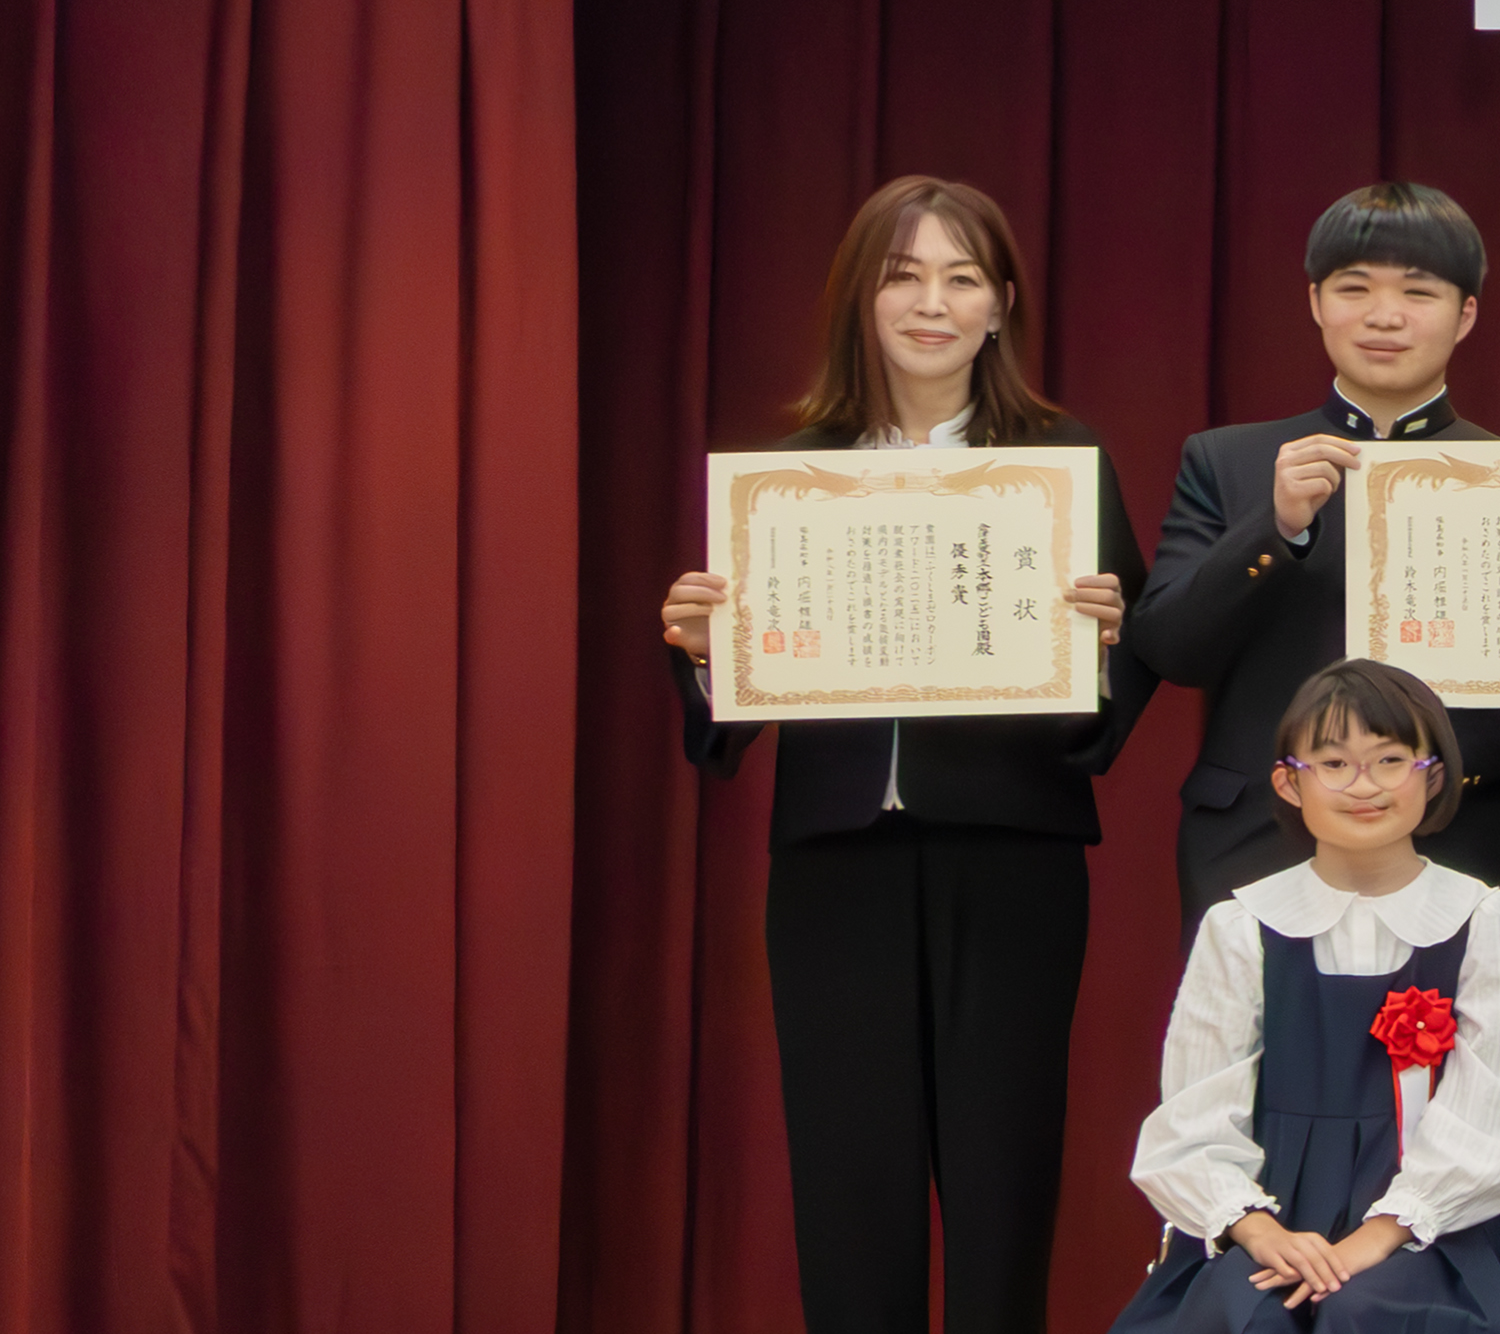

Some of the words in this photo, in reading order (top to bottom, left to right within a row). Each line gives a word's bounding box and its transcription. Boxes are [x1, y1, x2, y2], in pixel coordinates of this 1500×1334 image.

[950, 542, 969, 605] 優秀賞
[1012, 545, 1039, 621] 賞状
